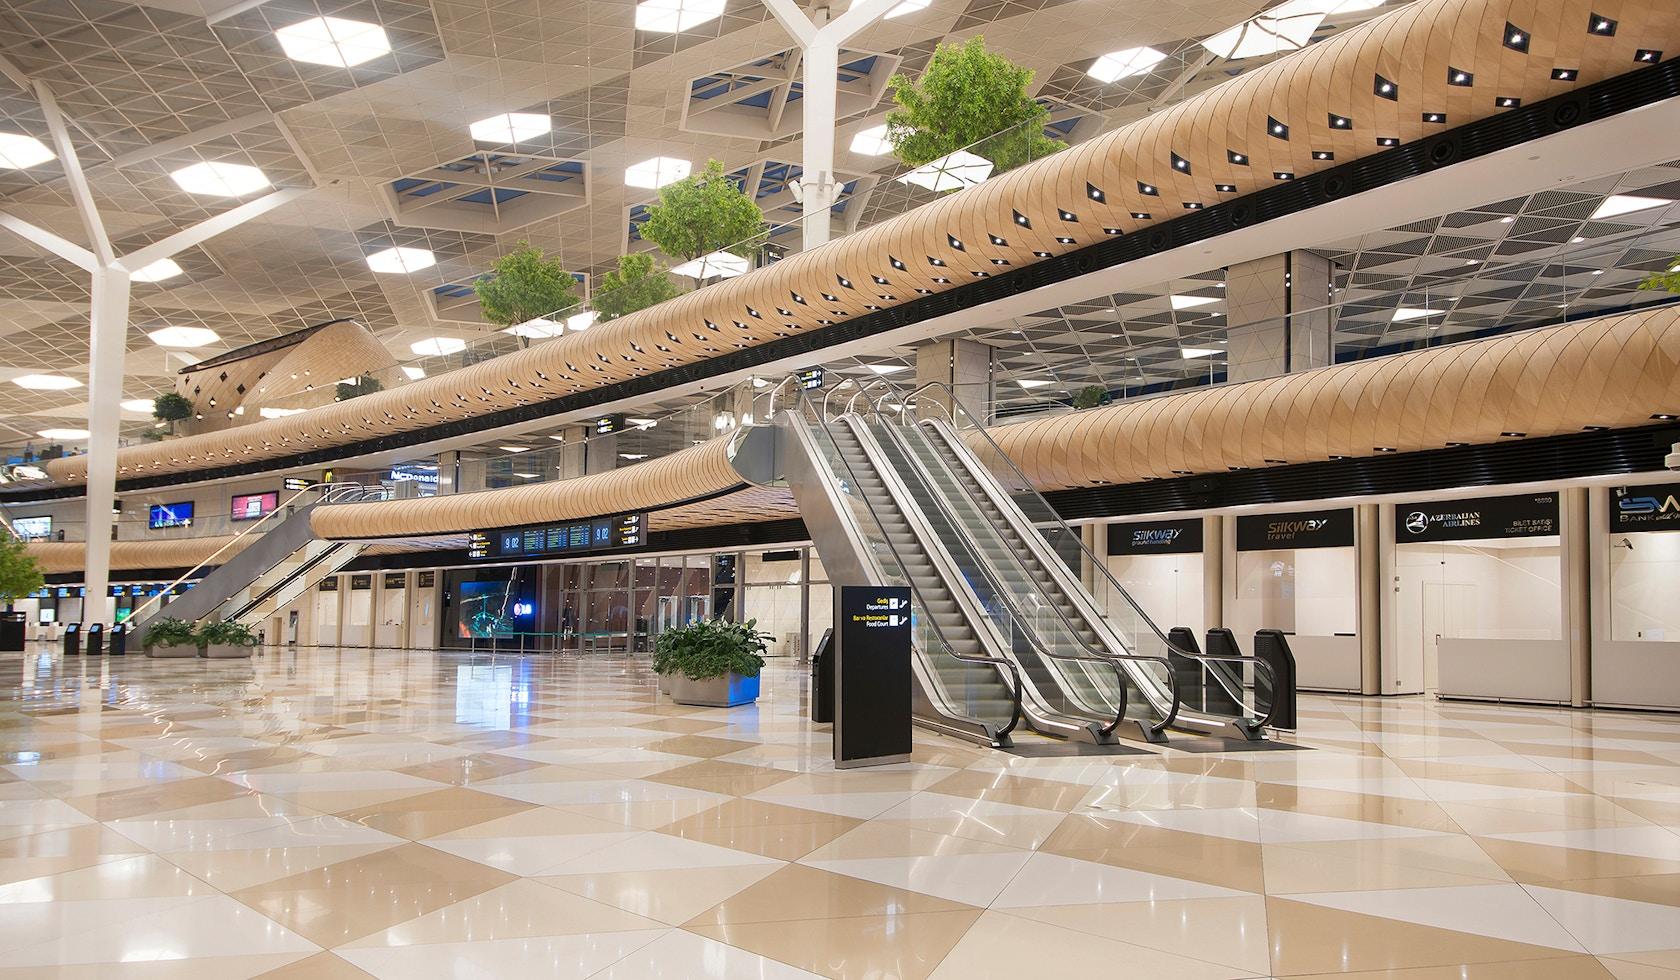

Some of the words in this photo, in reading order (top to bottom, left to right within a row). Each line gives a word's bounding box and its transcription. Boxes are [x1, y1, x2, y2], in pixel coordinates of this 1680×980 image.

[1430, 512, 1480, 522] AZERBAIJAN
[1442, 519, 1481, 528] AIRLINES
[1528, 525, 1553, 533] OFFICE
[1267, 532, 1296, 540] travel
